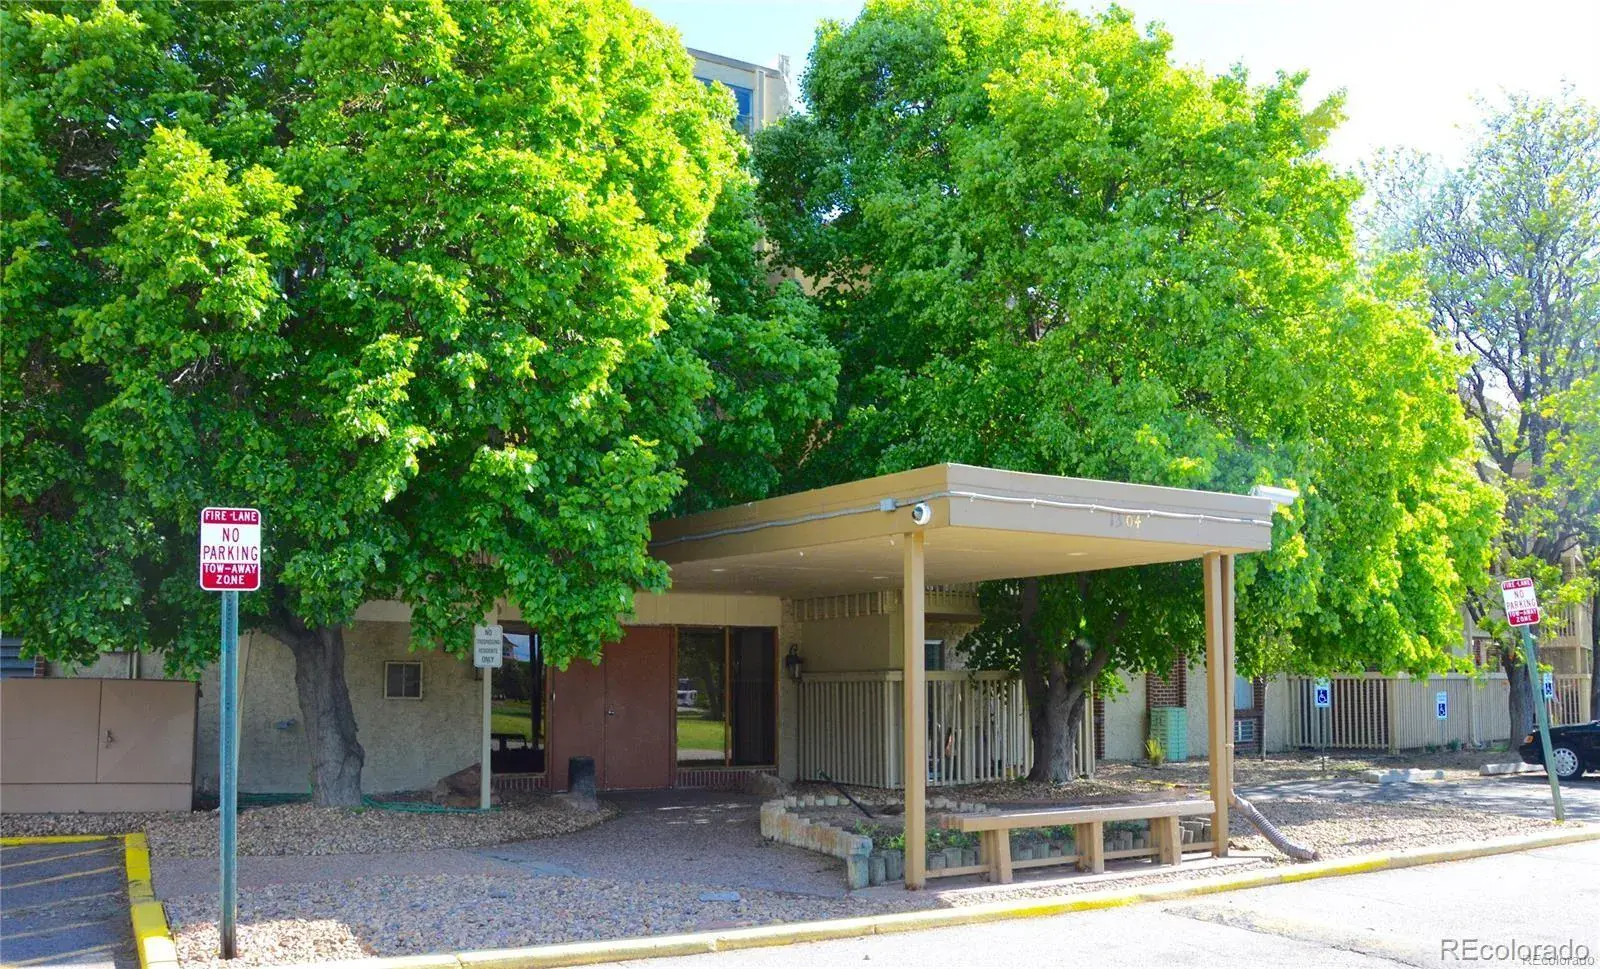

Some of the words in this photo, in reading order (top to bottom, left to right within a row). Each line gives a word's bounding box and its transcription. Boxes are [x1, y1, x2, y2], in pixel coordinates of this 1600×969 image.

[205, 511, 227, 520] FIRE
[232, 511, 257, 521] LANE
[222, 528, 240, 542] NO
[203, 545, 258, 560] PARKING
[204, 563, 256, 573] TOW-AWAY
[216, 575, 245, 585] ZONE
[1514, 590, 1524, 598] NO
[1506, 599, 1536, 610] PARKING
